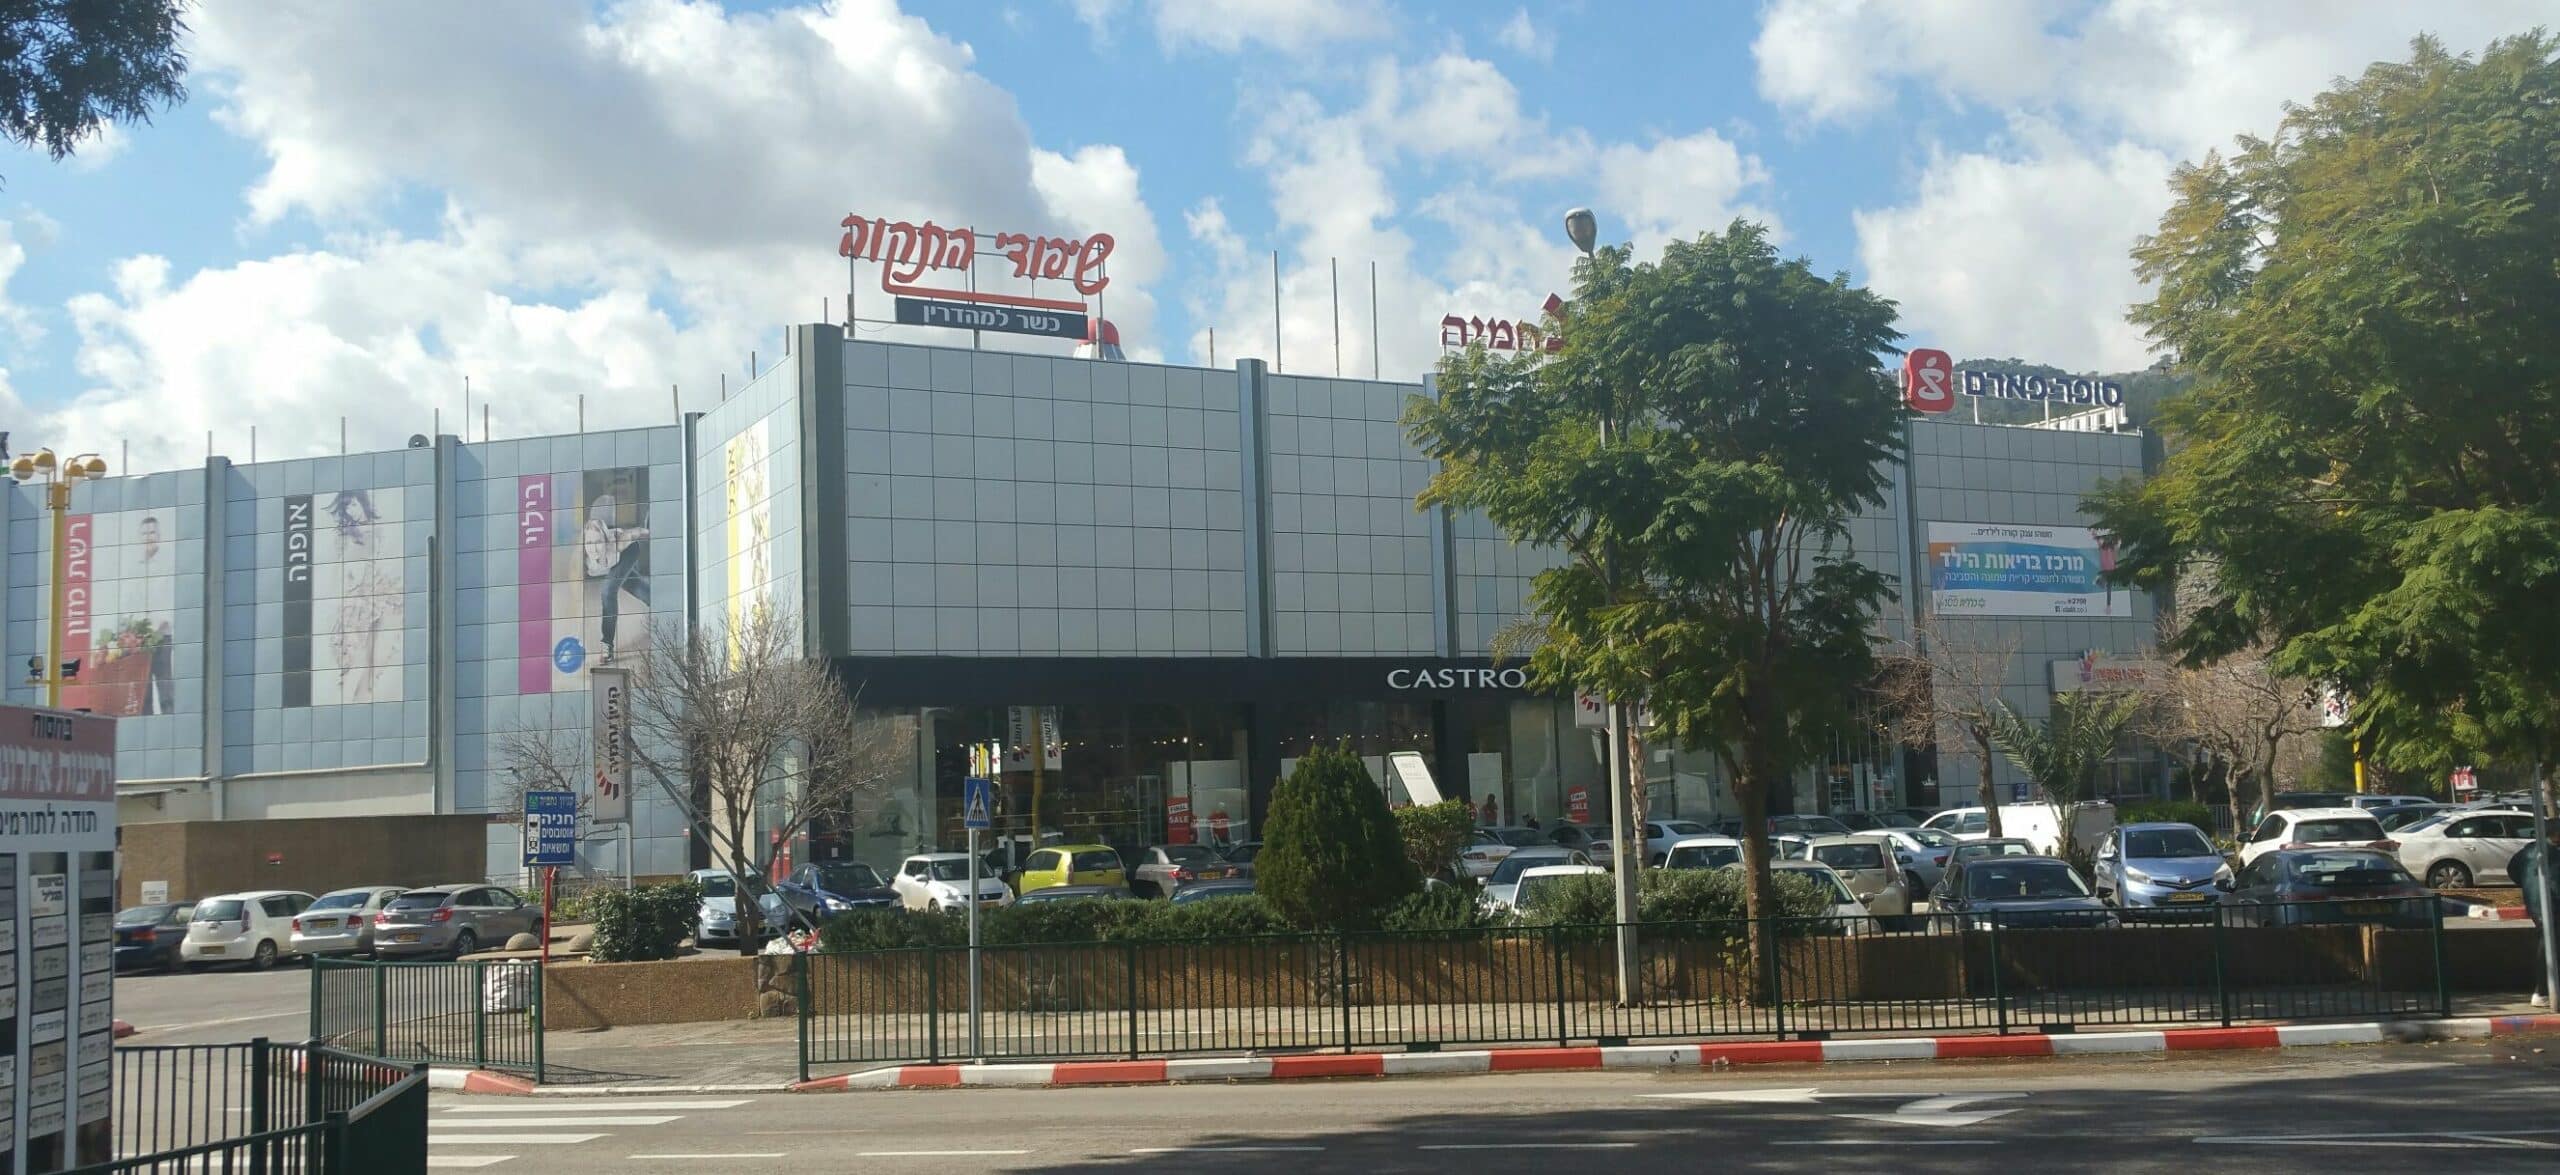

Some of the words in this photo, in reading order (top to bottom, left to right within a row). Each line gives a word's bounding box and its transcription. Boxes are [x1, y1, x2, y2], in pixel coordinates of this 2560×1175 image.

[839, 215, 976, 290] התקוה
[996, 232, 1115, 295] שיפודי
[923, 305, 1009, 327] למהדרין
[1016, 314, 1061, 332] כשר
[525, 482, 544, 545] בילוי
[68, 521, 87, 578] רשת
[289, 503, 308, 582] אופנה
[1939, 545, 1979, 569] הילד
[1985, 553, 2042, 570] בריאות
[2045, 554, 2084, 571] מרכז
[68, 588, 90, 636] מזון
[1387, 668, 1527, 689] CASTRO
[607, 686, 621, 721] קניון
[61, 810, 98, 833] תודה
[541, 813, 574, 825] חניה
[541, 827, 574, 838] אוטובוסים
[541, 843, 570, 854] ומשאיות
